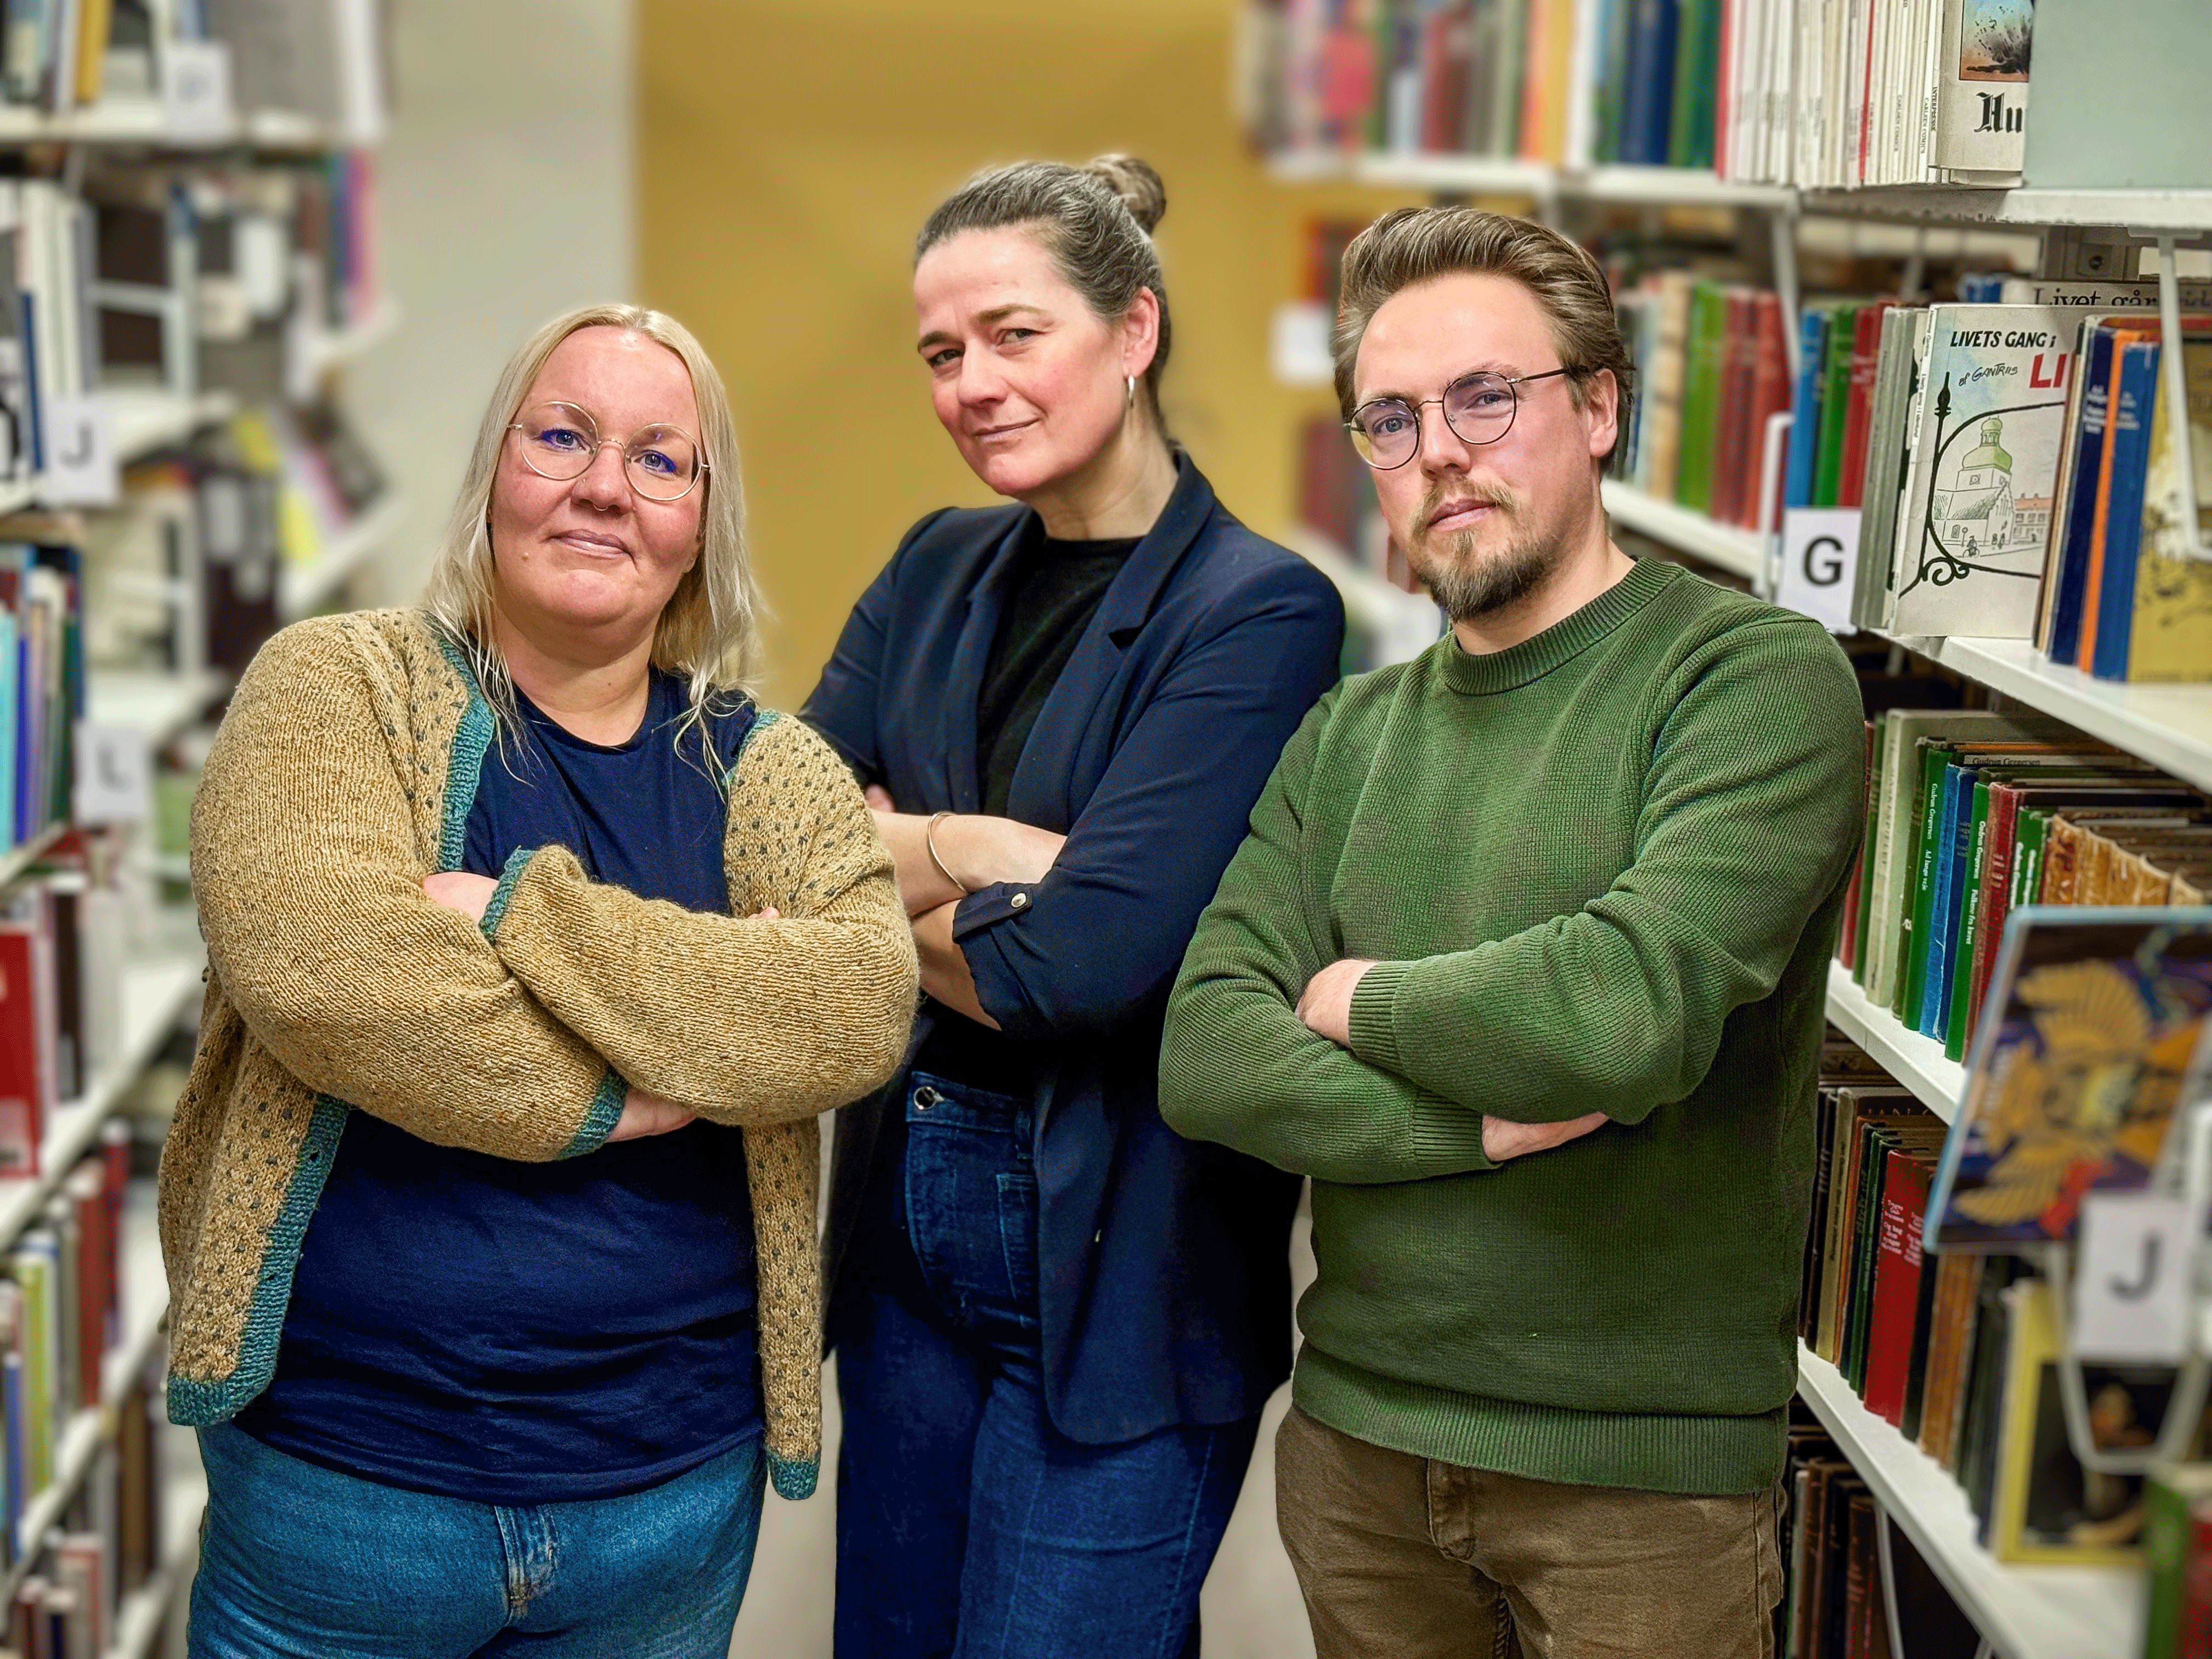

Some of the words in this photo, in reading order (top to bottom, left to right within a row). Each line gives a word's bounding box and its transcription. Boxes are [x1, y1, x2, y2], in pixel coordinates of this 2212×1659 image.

[1950, 331, 2002, 348] LIVETS
[2005, 331, 2048, 348] GANG
[1958, 372, 1971, 387] af
[1803, 535, 1843, 587] G
[1930, 783, 1938, 808] Gudrun
[1927, 808, 1936, 840] Gregersen
[1977, 821, 1987, 847] Gudrun
[1922, 859, 1931, 877] lange
[1973, 847, 1983, 879] Gregersen
[1970, 888, 1979, 913] Folkene
